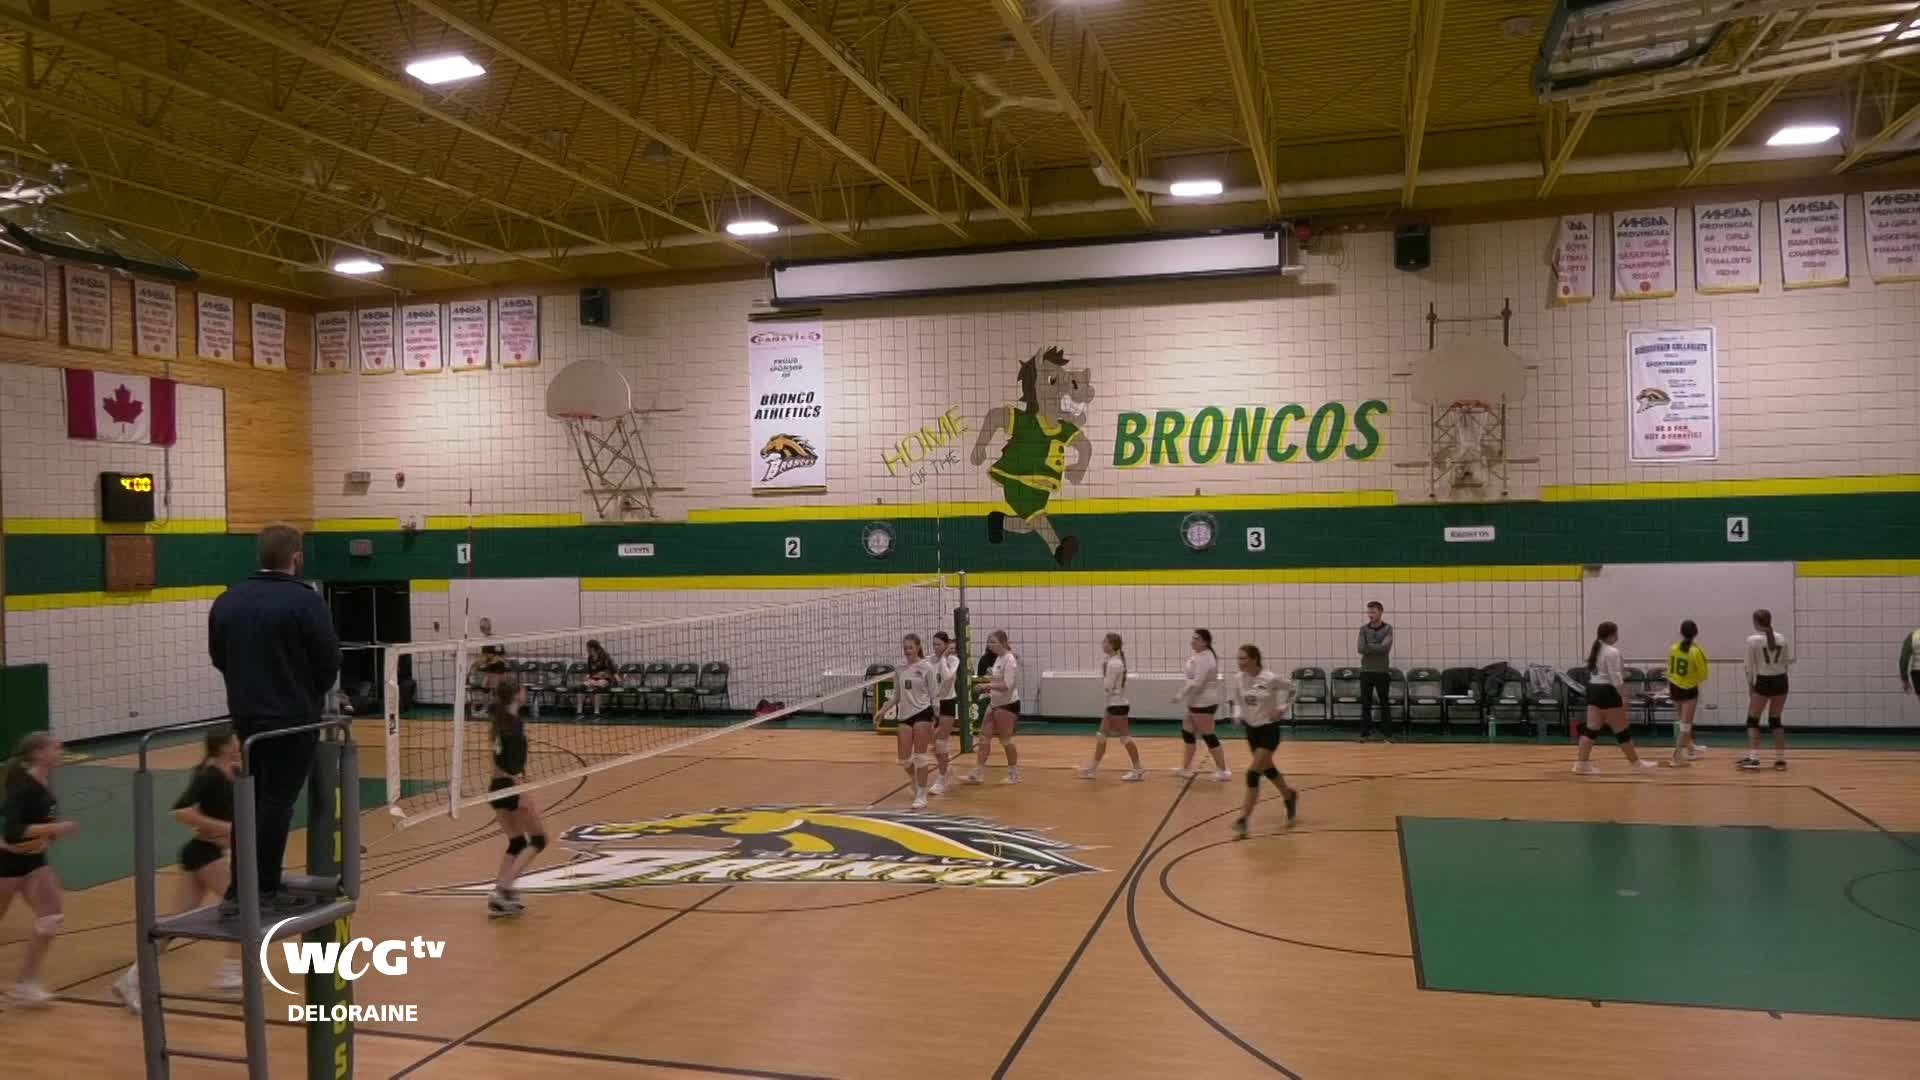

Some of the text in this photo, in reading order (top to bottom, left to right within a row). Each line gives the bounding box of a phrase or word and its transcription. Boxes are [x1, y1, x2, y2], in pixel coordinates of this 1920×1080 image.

[760, 391, 815, 406] BRONCO
[754, 405, 822, 420] ATHLETICS
[881, 405, 968, 478] HOME
[1112, 399, 1392, 469] BRONCOS
[911, 450, 960, 486] OF THE
[1730, 520, 1744, 538] 4
[788, 540, 797, 556] 2
[1250, 531, 1262, 548] 3
[1763, 644, 1782, 664] 17
[1669, 656, 1689, 677] 18
